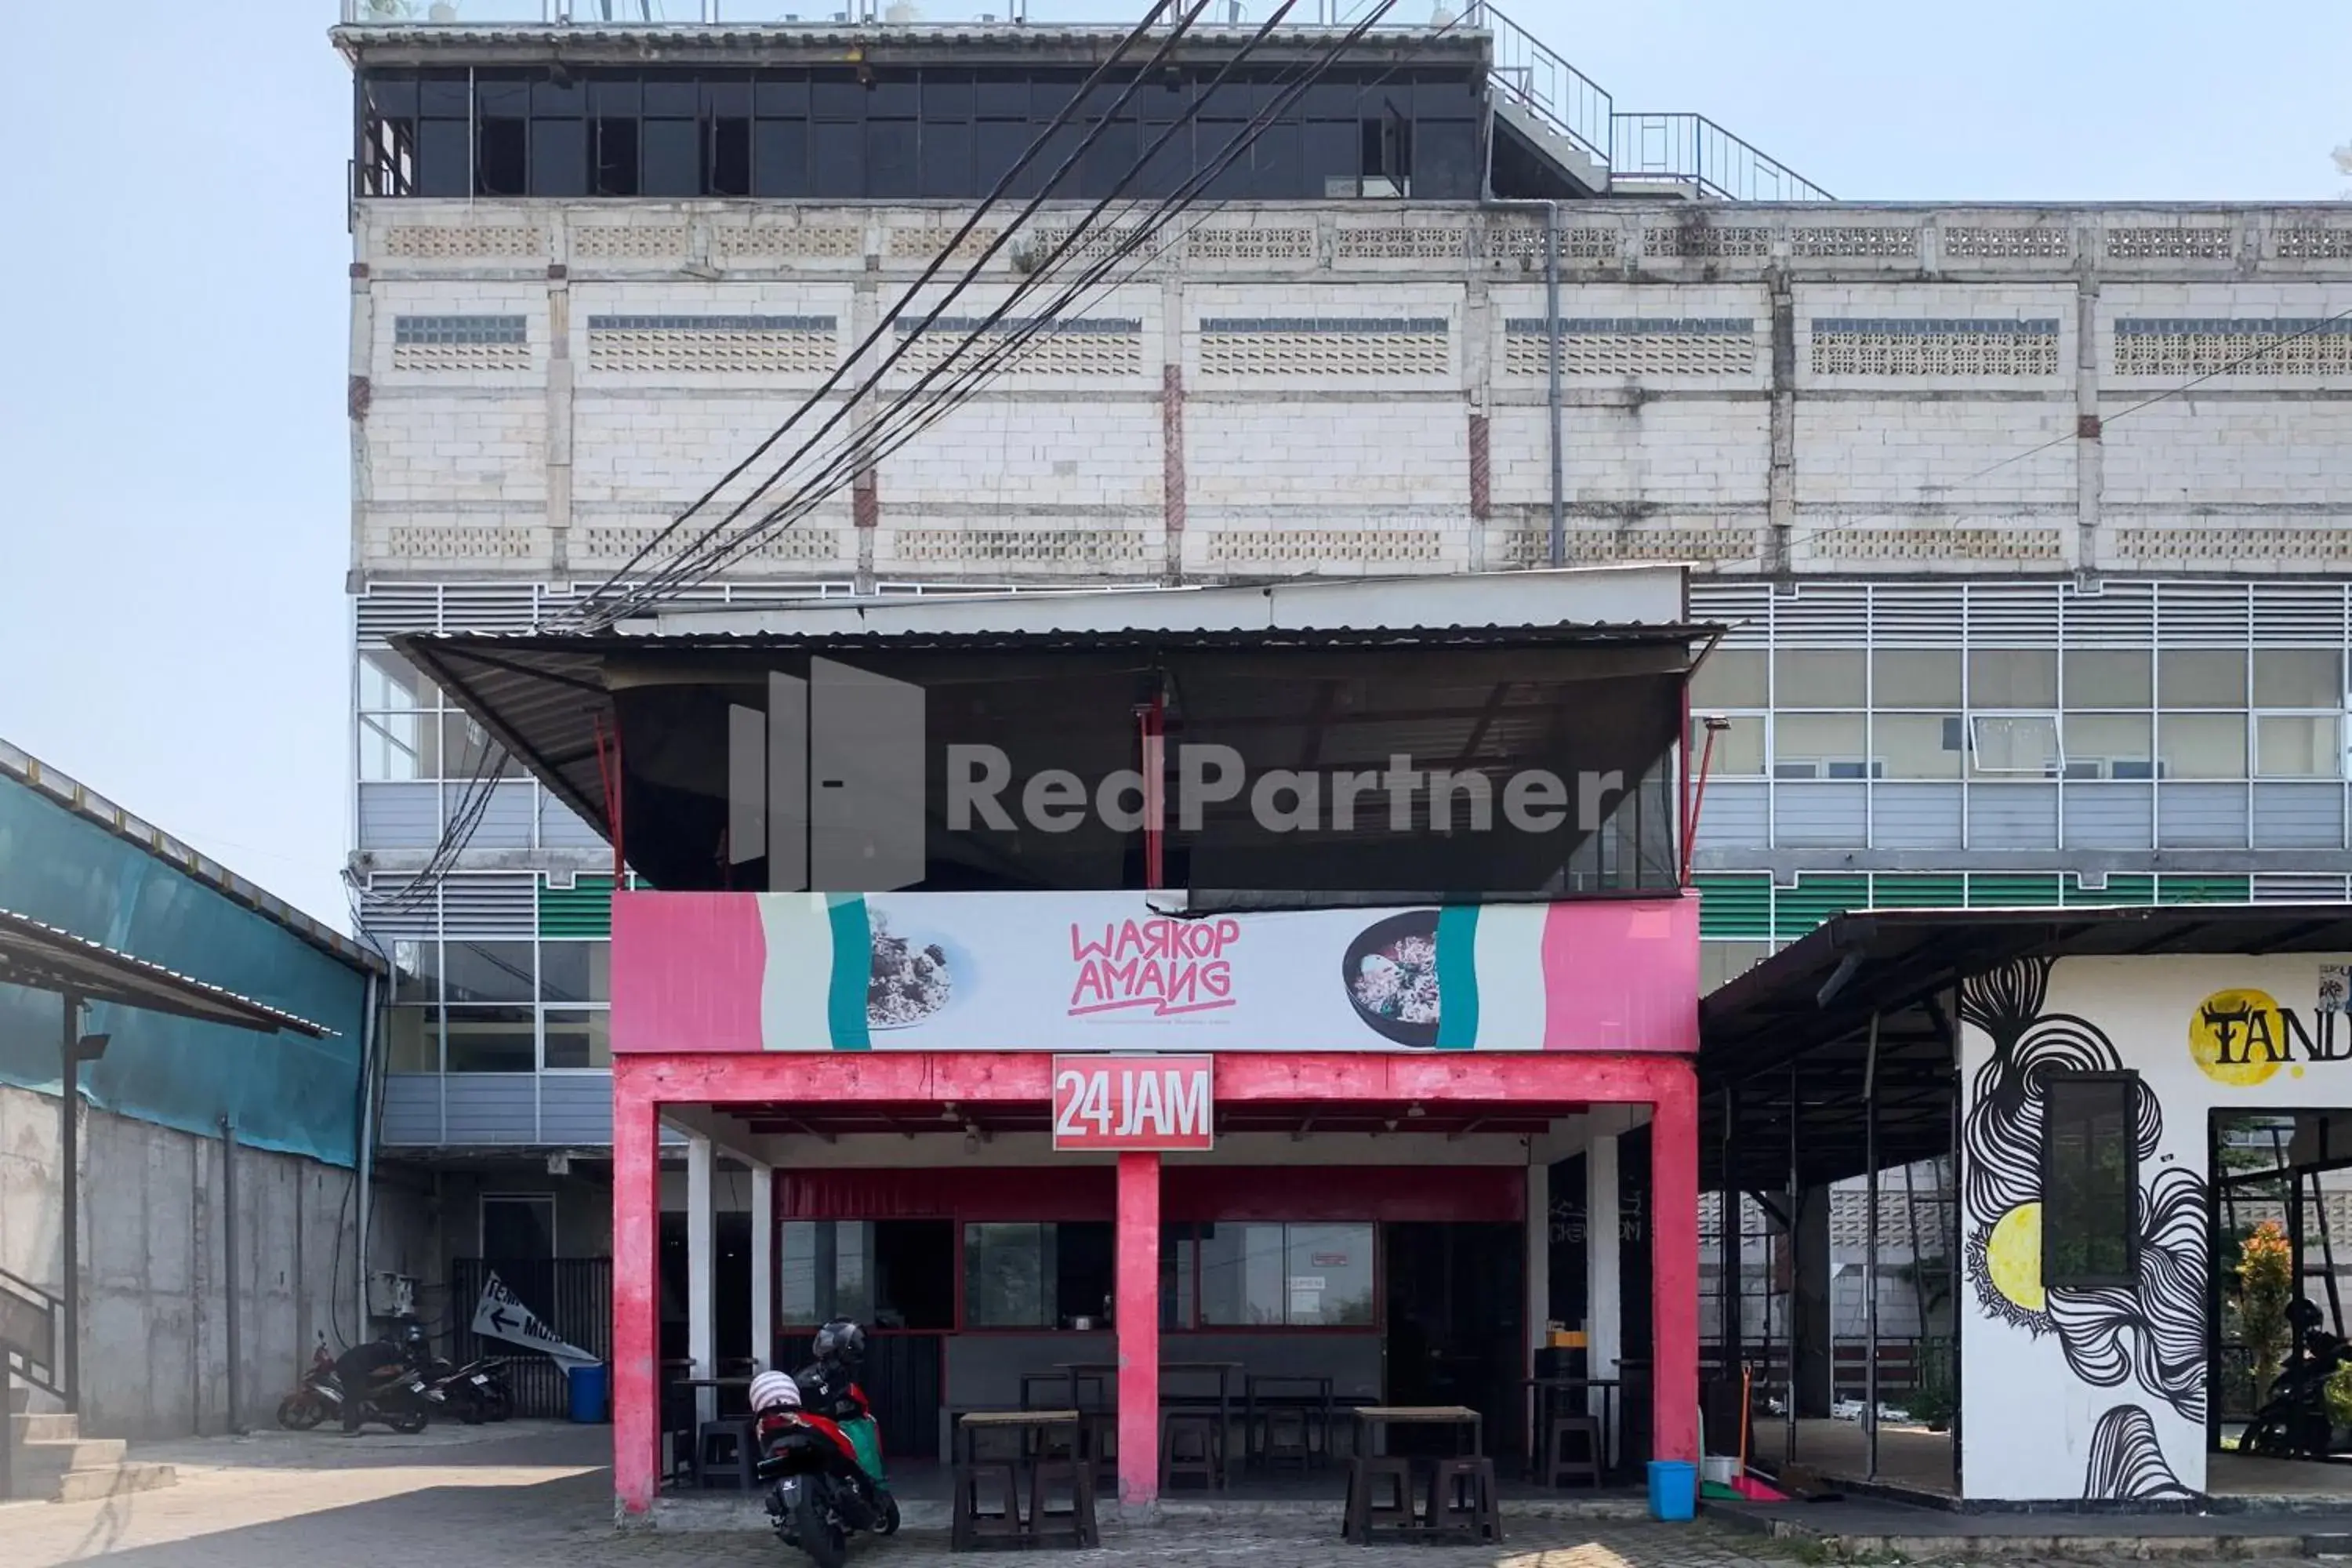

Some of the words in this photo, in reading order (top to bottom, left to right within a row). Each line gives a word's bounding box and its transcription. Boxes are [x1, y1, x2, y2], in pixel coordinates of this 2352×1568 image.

[1071, 919, 1240, 962] WARKOP
[1071, 957, 1231, 1005] AMANG
[1056, 1070, 1113, 1136] 24
[1114, 1070, 1209, 1136] JAM
